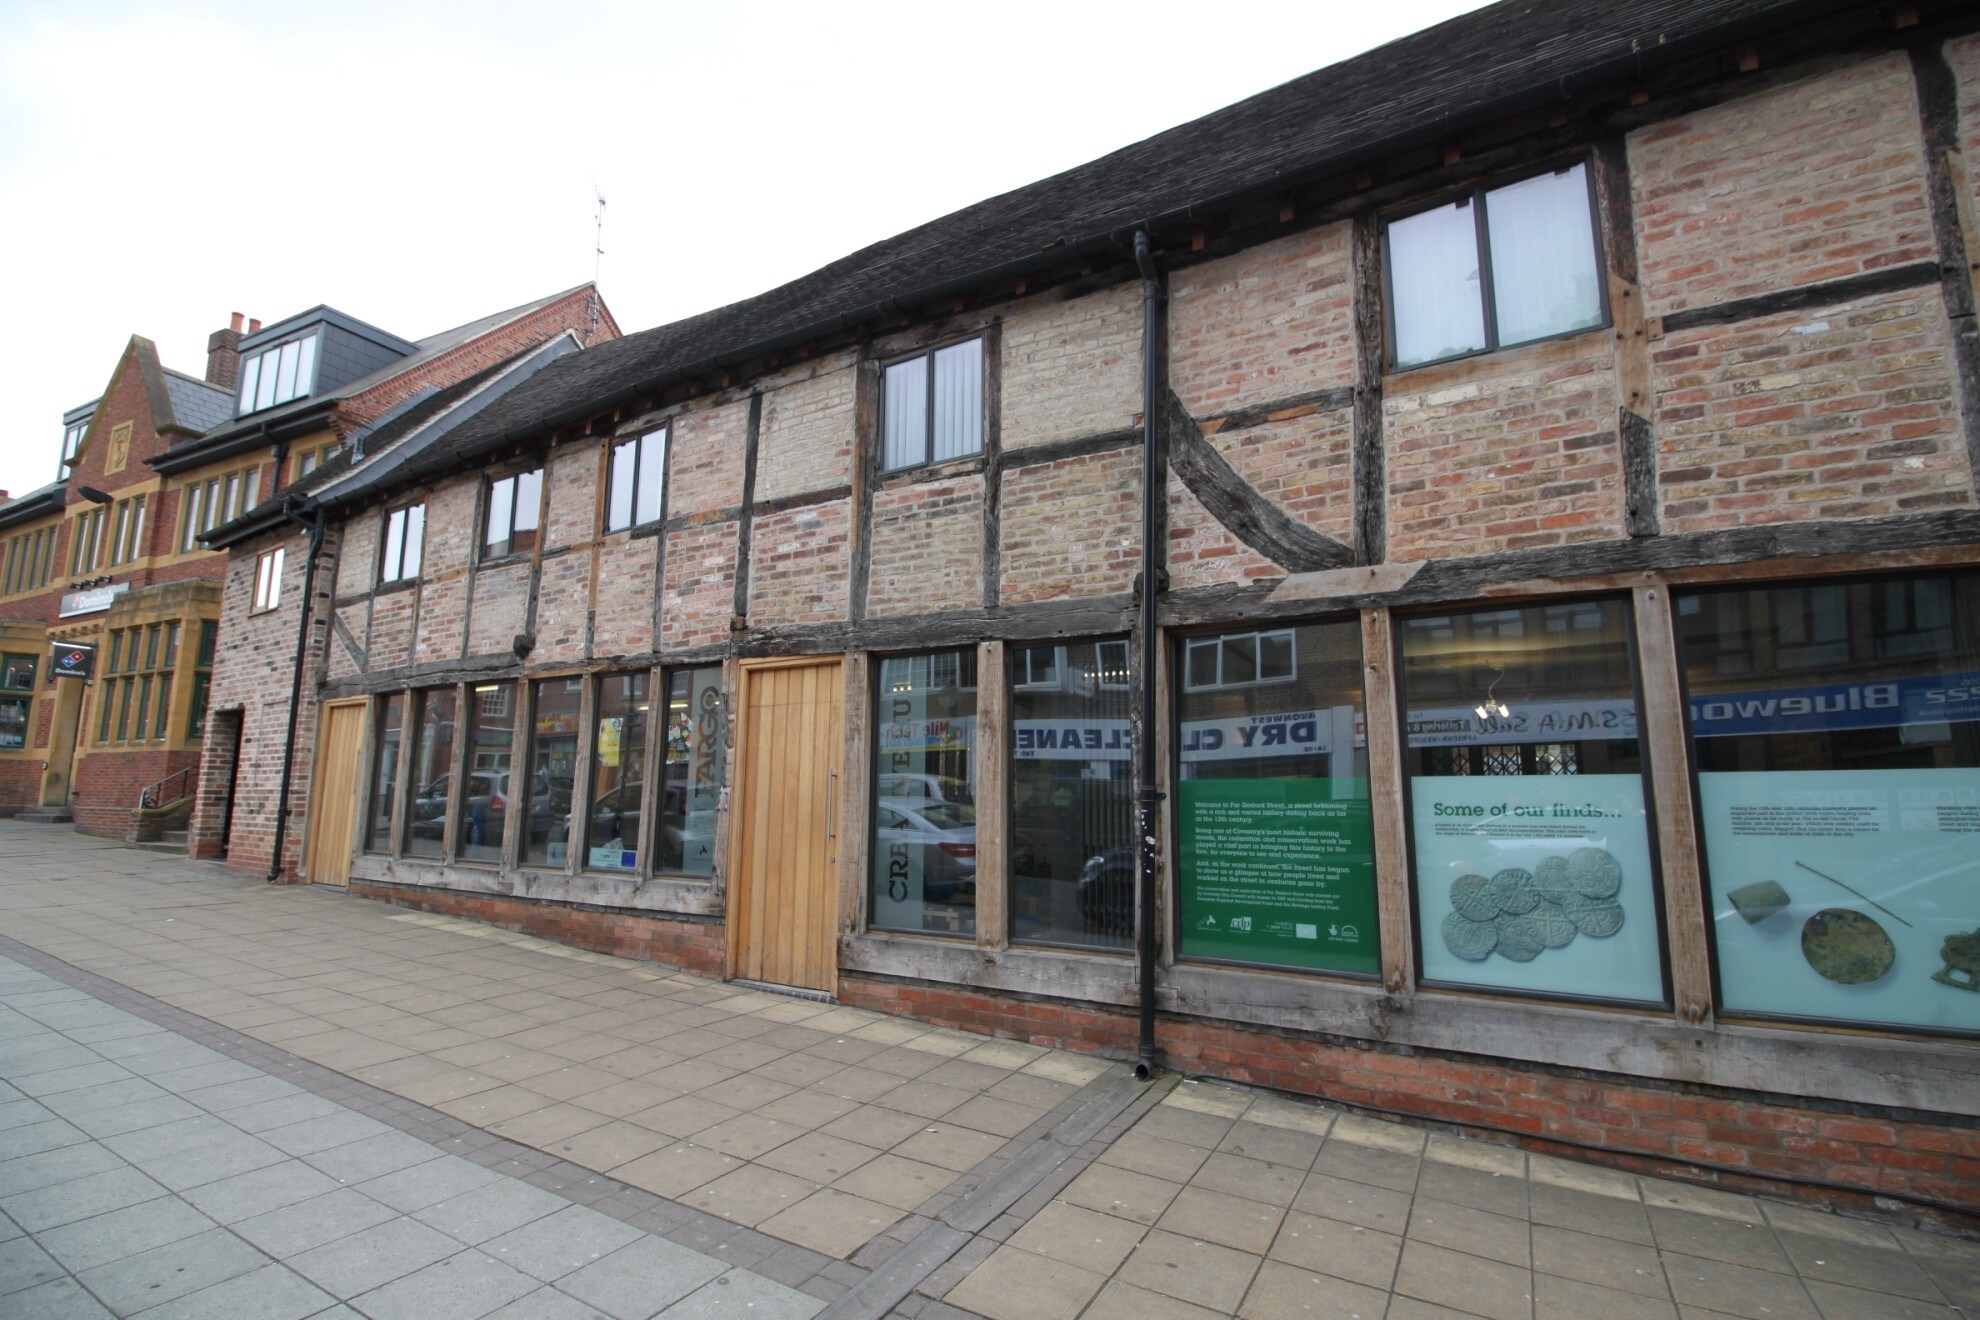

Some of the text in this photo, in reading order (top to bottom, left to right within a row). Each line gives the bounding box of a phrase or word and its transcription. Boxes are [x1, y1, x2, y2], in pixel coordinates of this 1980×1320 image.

[79, 590, 114, 609] Domino's
[55, 668, 86, 676] Domino's
[1434, 802, 1484, 817] Some
[1490, 803, 1507, 817] of
[1513, 806, 1545, 817] our
